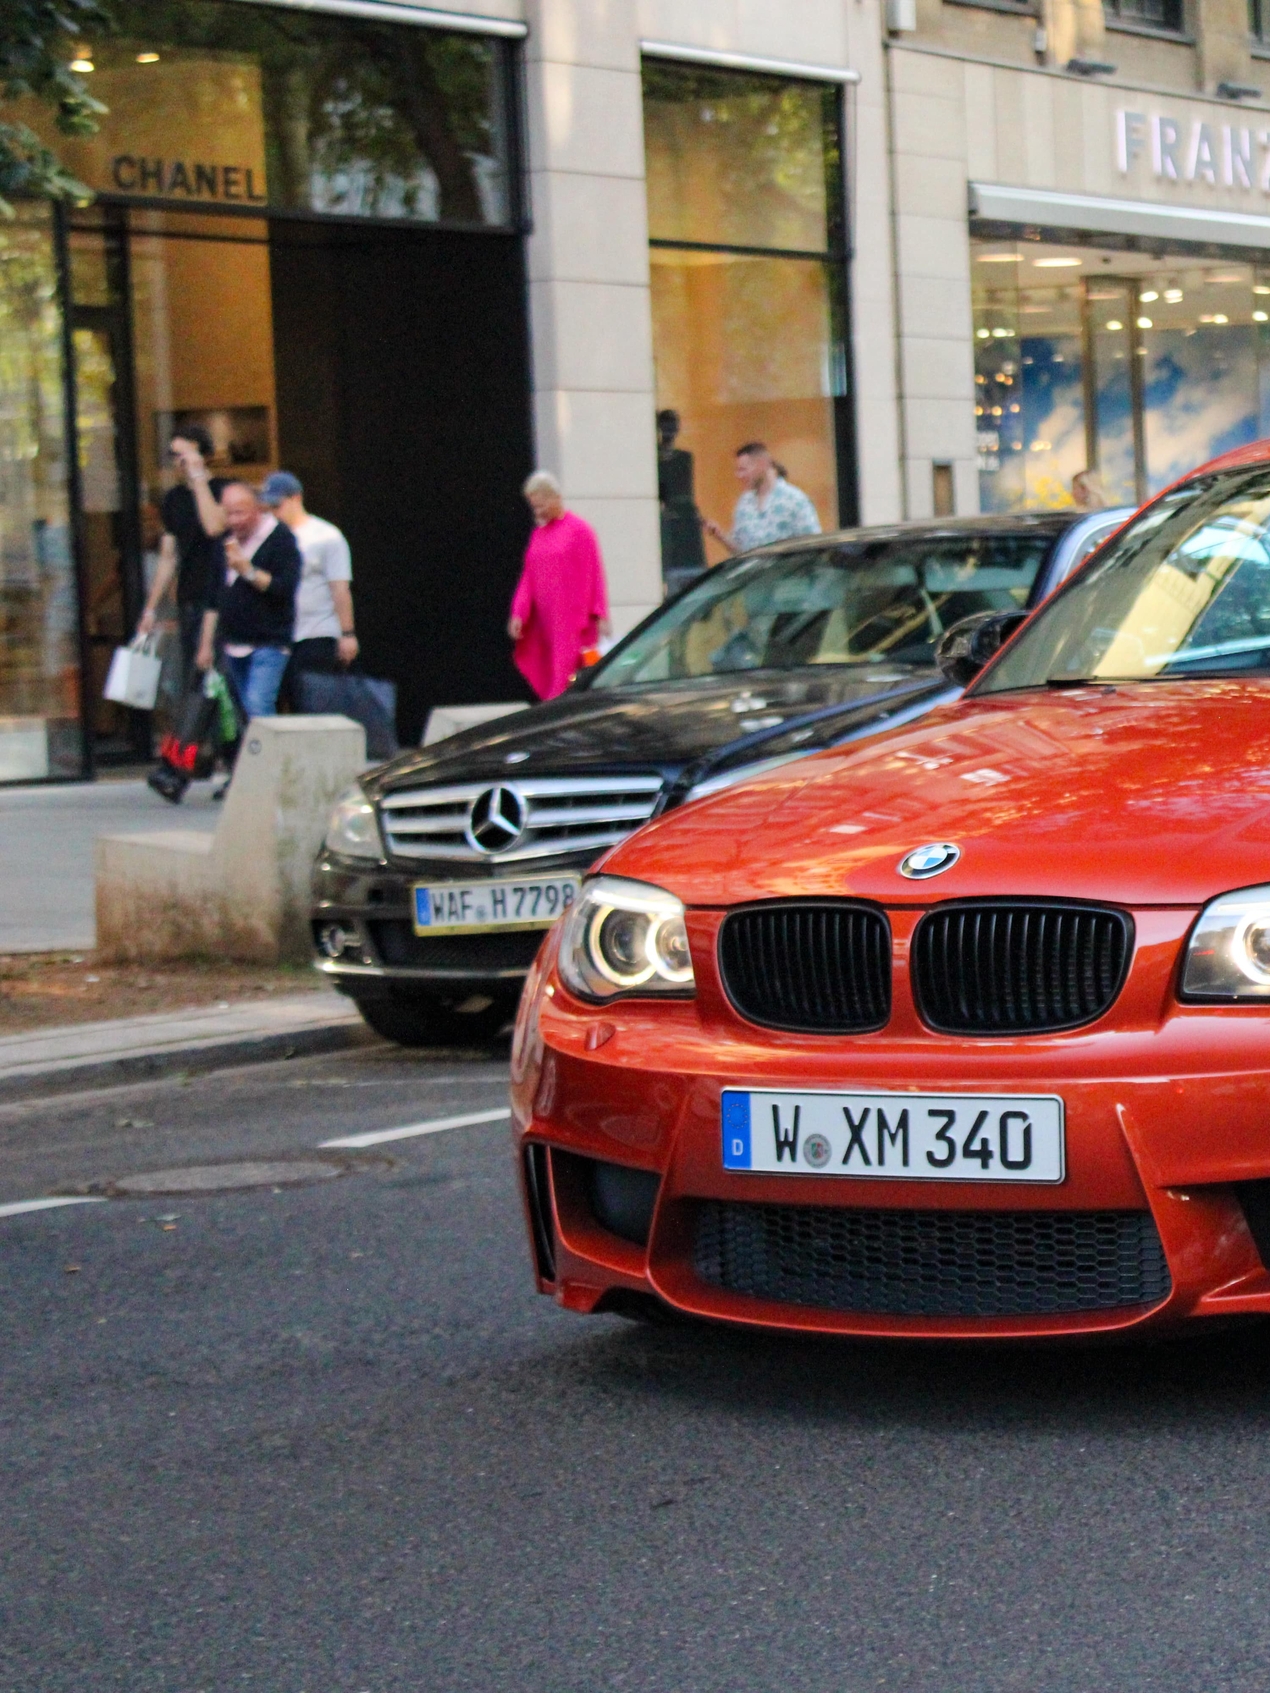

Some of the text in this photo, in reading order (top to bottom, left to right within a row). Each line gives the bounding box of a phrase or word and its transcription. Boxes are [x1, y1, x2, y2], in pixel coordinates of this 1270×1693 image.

[112, 155, 266, 200] CHANEL
[432, 890, 474, 922] WAF
[491, 888, 508, 919] H
[732, 1139, 744, 1156] D
[772, 1104, 800, 1162] W
[841, 1106, 910, 1167] XM
[926, 1108, 1032, 1171] 340
